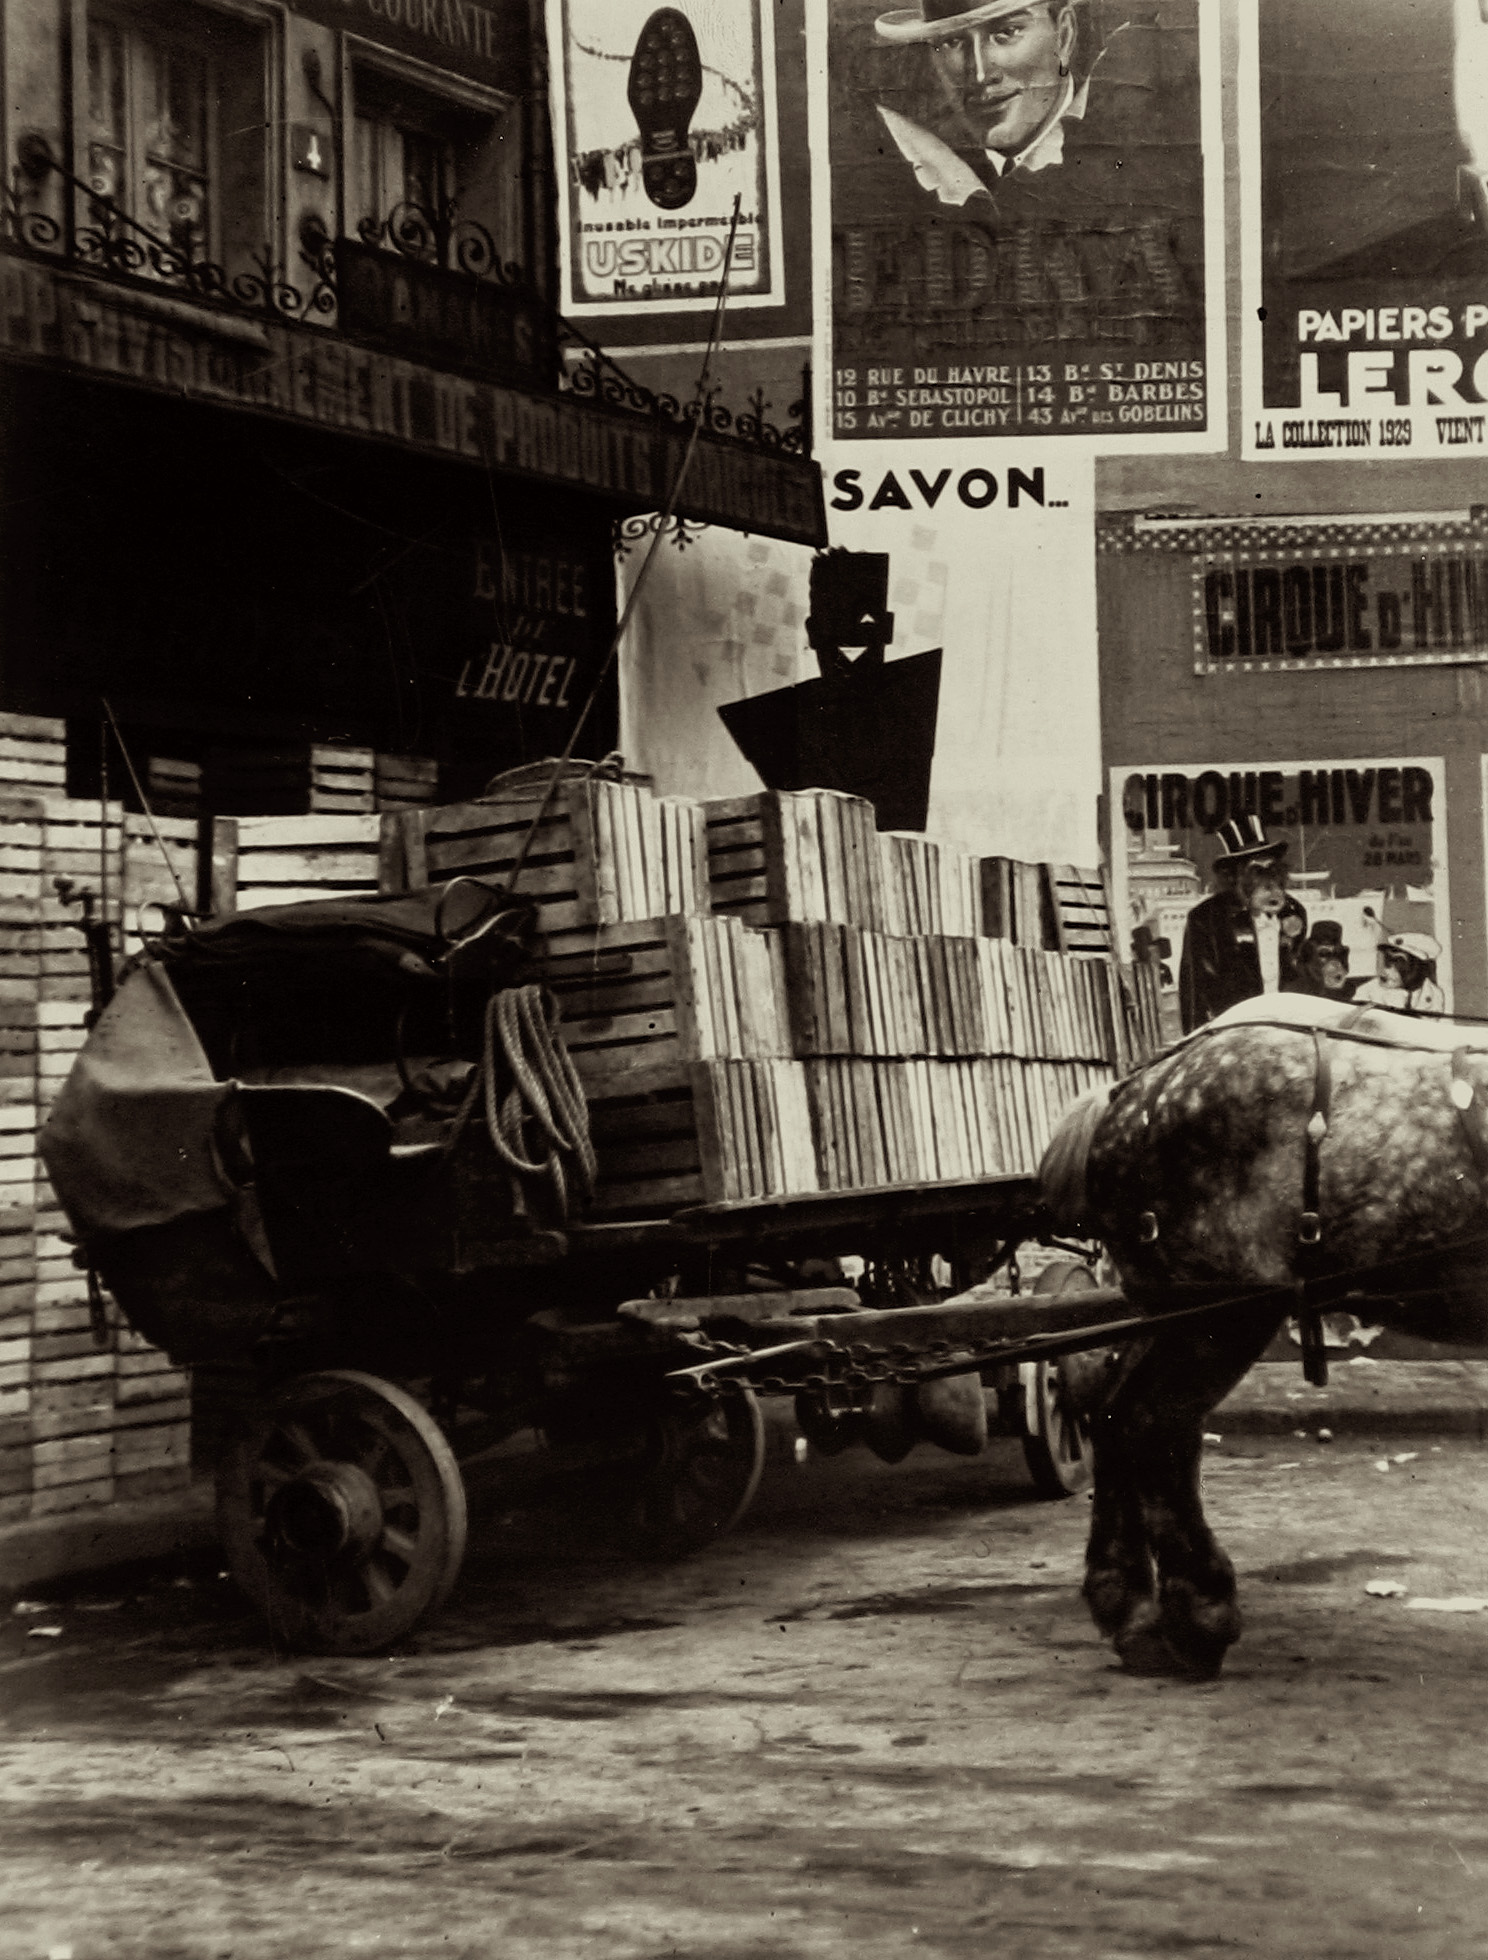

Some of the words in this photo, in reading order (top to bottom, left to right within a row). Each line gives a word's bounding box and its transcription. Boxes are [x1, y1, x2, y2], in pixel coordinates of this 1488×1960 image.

[369, 0, 499, 60] URANTE
[587, 233, 755, 277] USKIDE
[1299, 306, 1453, 342] PAPIERS
[867, 367, 904, 386] RUE
[914, 367, 938, 385] DU
[948, 365, 1011, 384] HAVRE
[1027, 364, 1052, 382] 13
[1134, 361, 1204, 380] DENIS
[1301, 348, 1488, 408] LER
[837, 390, 857, 407] 10
[896, 386, 1012, 407] SEBASTOPOL
[1027, 385, 1056, 404] 14
[1109, 382, 1205, 402] BARBES
[837, 410, 857, 428] 15
[910, 409, 935, 427] DE
[942, 407, 1011, 427] CLICHY
[1027, 407, 1052, 426] 43
[1118, 403, 1205, 423] GOBELINS
[1255, 420, 1276, 449] LA
[1283, 418, 1371, 448] COLLECTION
[1379, 418, 1412, 446] 1929
[1436, 416, 1486, 444] VIENT
[1204, 565, 1373, 658] CIRQUE
[1122, 770, 1285, 833] CIRQUE
